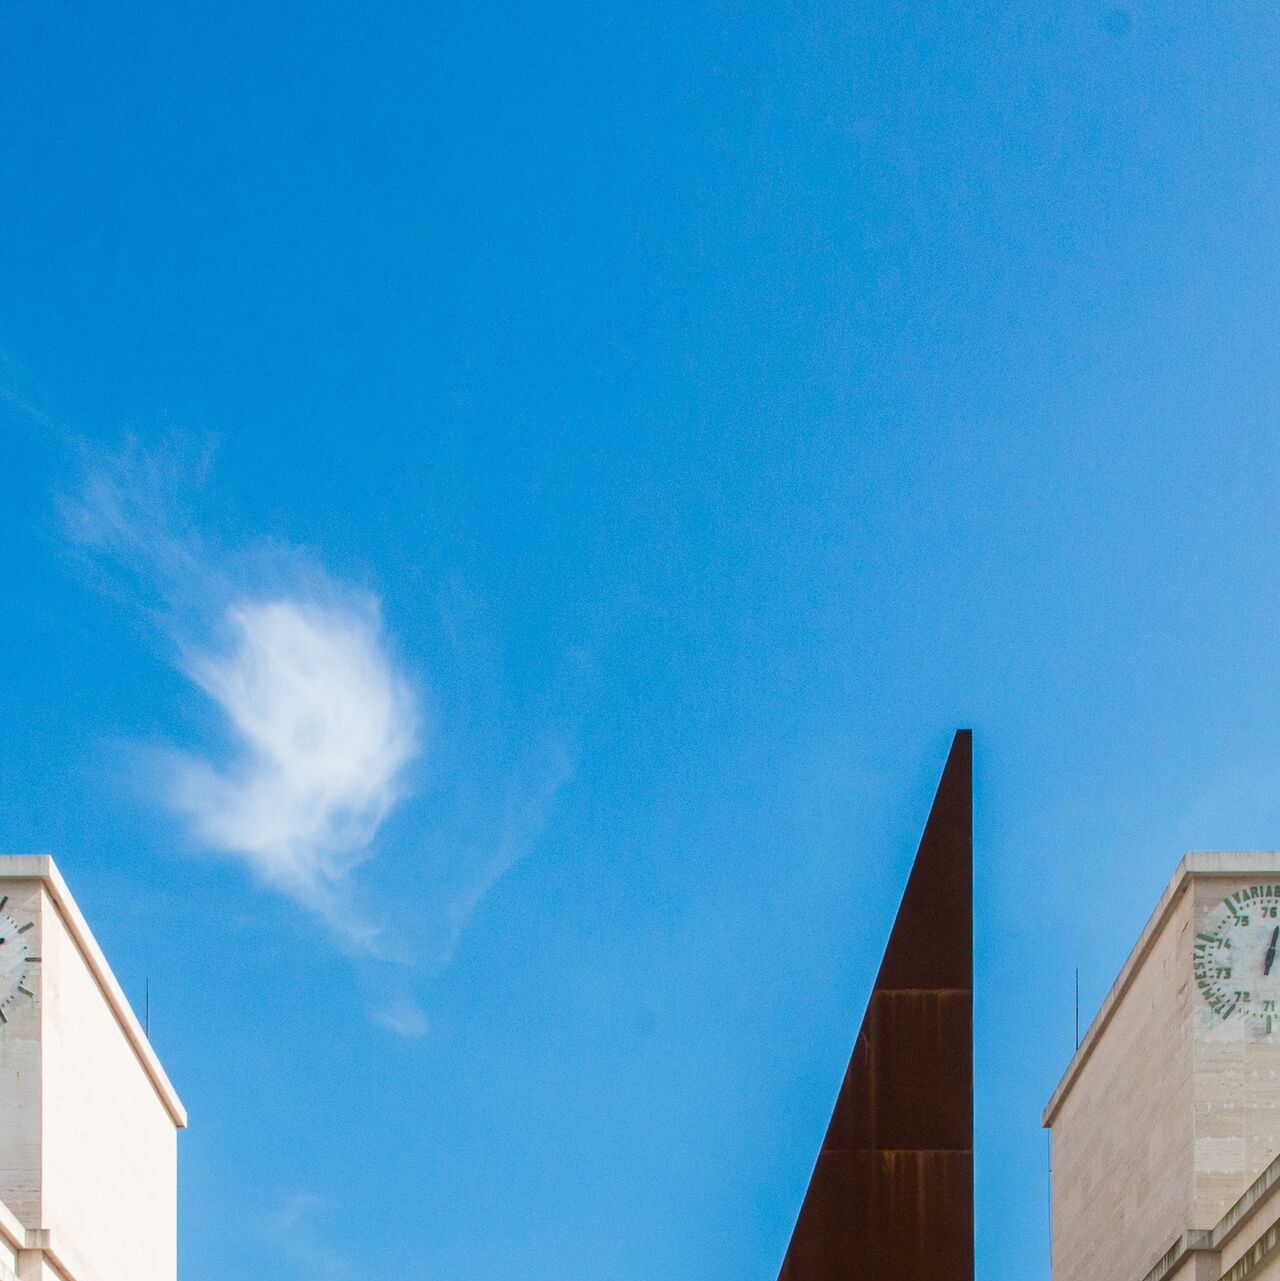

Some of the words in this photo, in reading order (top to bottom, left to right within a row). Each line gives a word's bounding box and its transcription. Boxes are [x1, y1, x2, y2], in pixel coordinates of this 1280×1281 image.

[1261, 907, 1278, 918] 76
[1233, 915, 1249, 927] 75
[1193, 943, 1225, 1014] TEMPESTA
[1215, 967, 1232, 979] 73
[1234, 991, 1251, 1003] 72
[1263, 1000, 1275, 1012] 71
